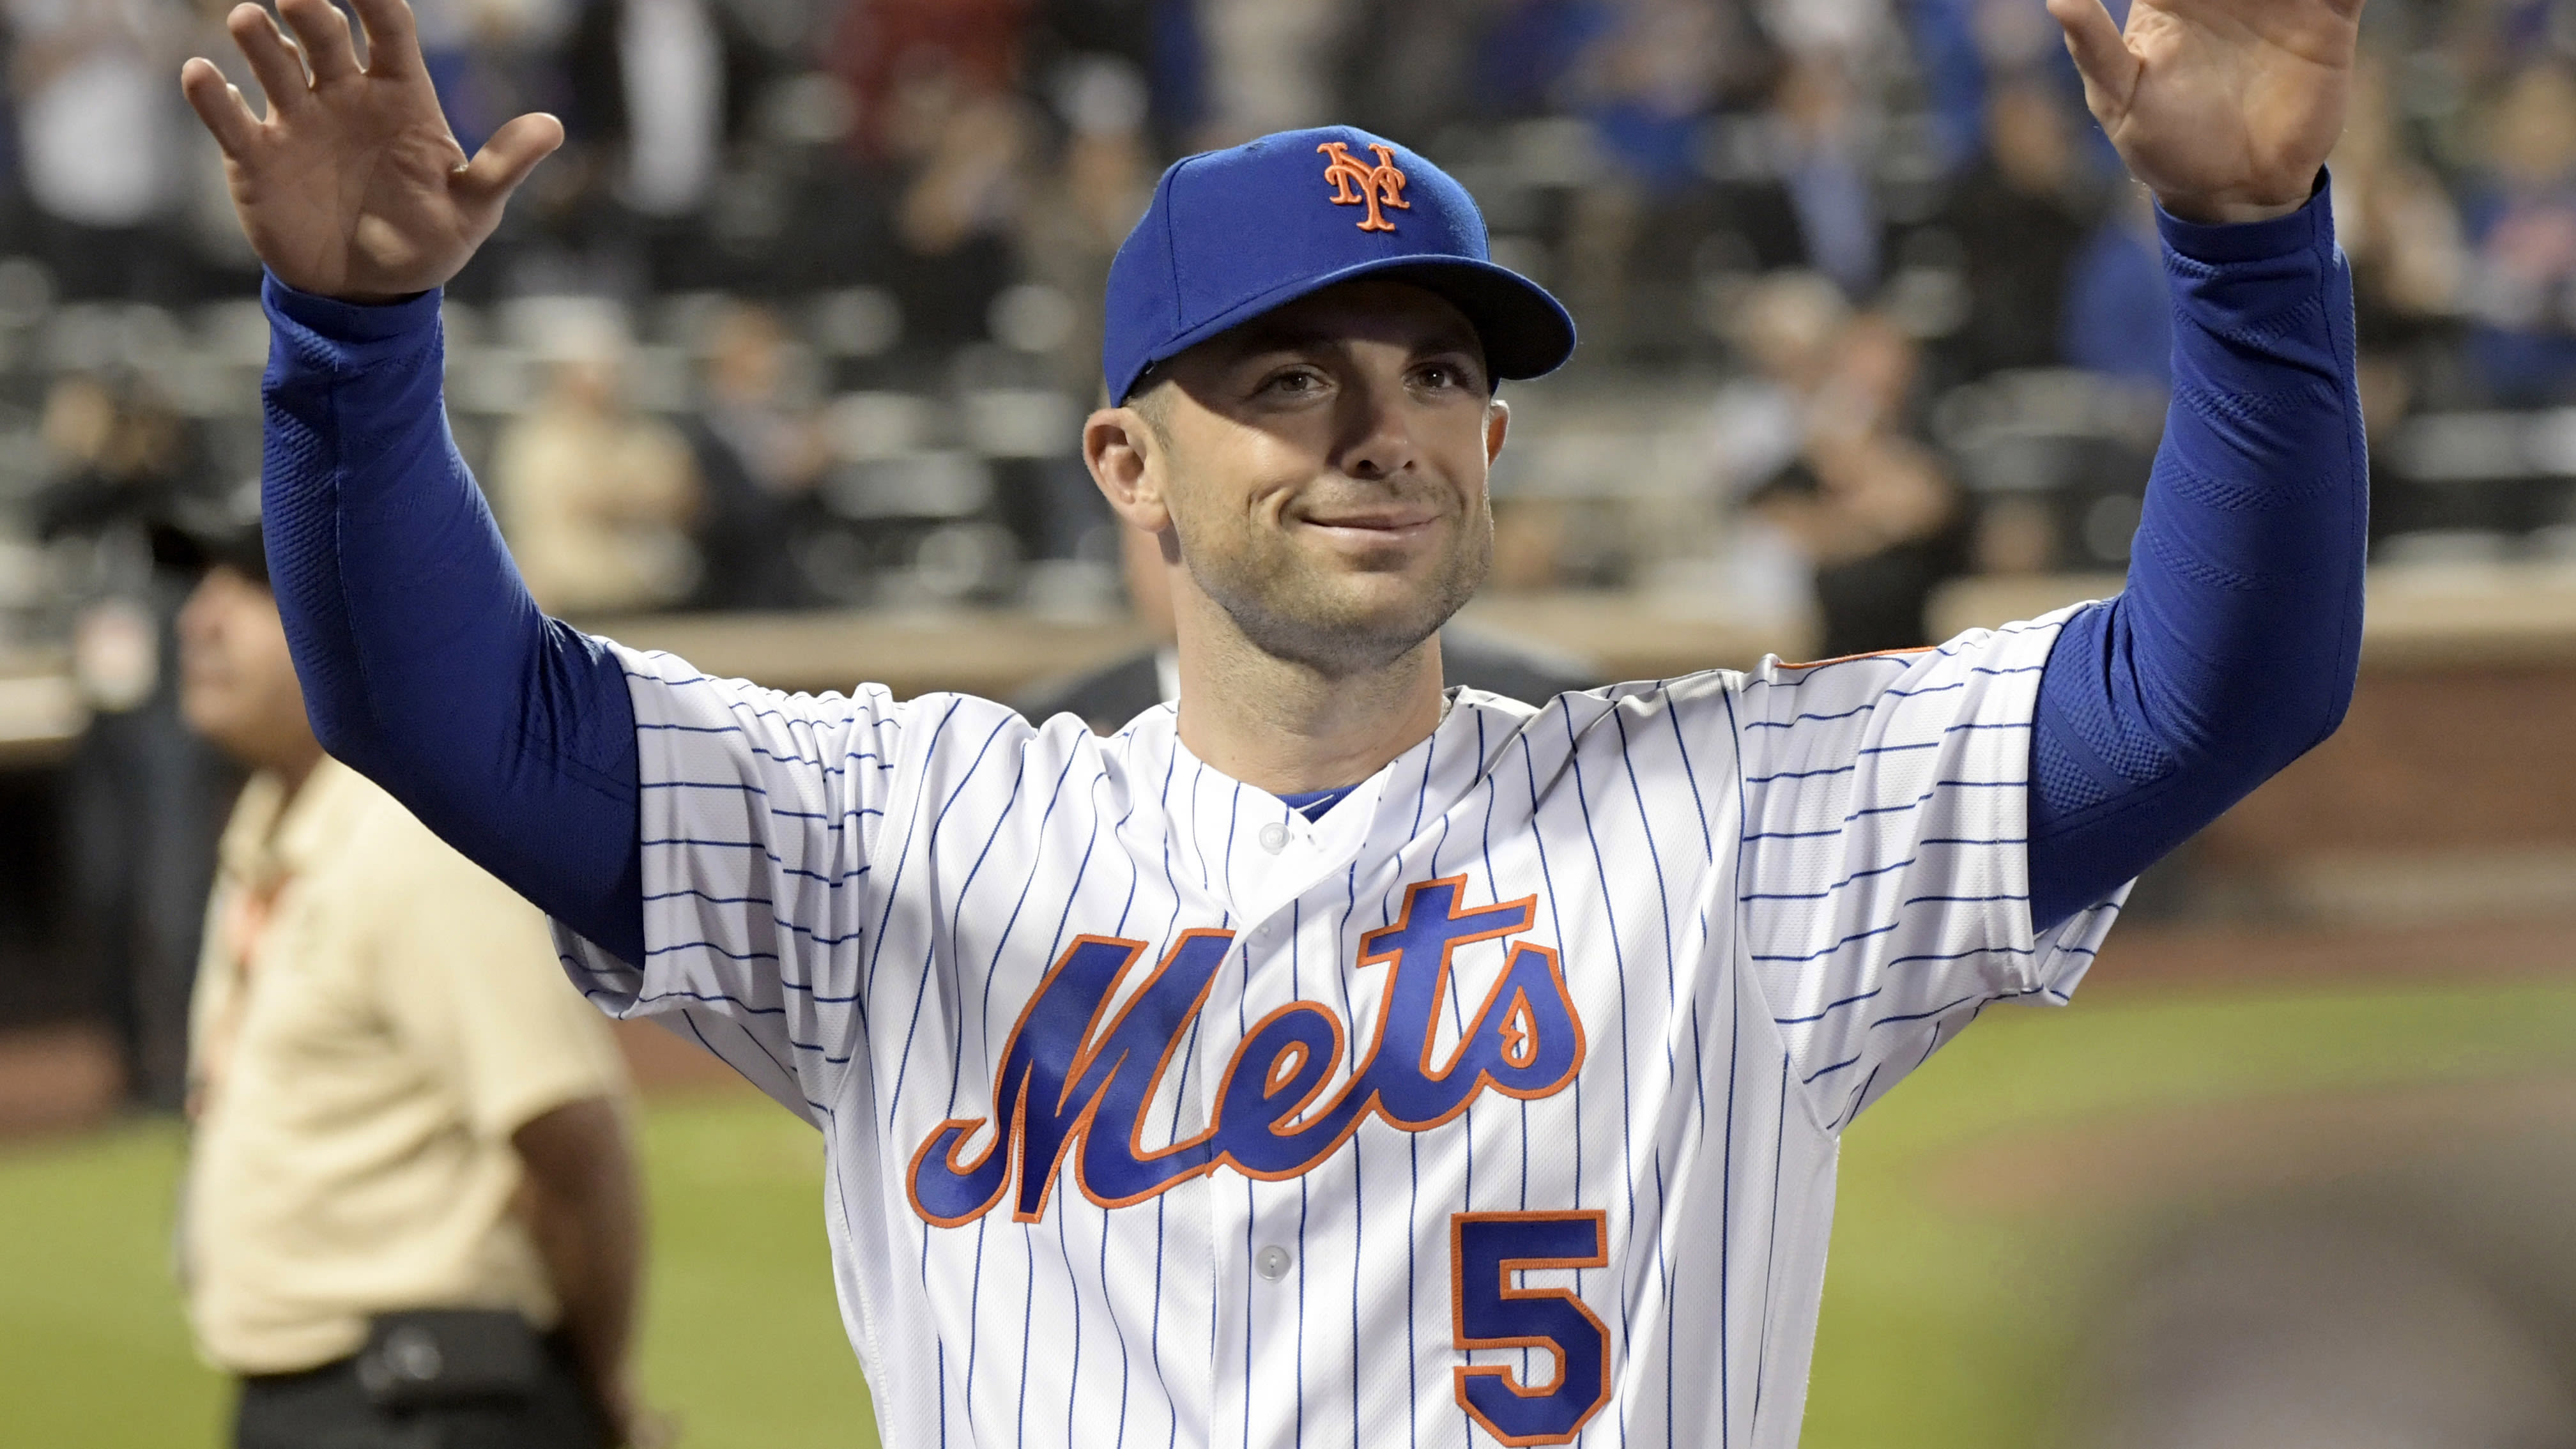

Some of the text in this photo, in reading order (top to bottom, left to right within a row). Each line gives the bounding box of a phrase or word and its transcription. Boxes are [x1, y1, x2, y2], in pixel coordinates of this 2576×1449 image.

[1316, 142, 1411, 231] NY
[907, 873, 1586, 1228] Mets
[1451, 1209, 1611, 1447] 5
